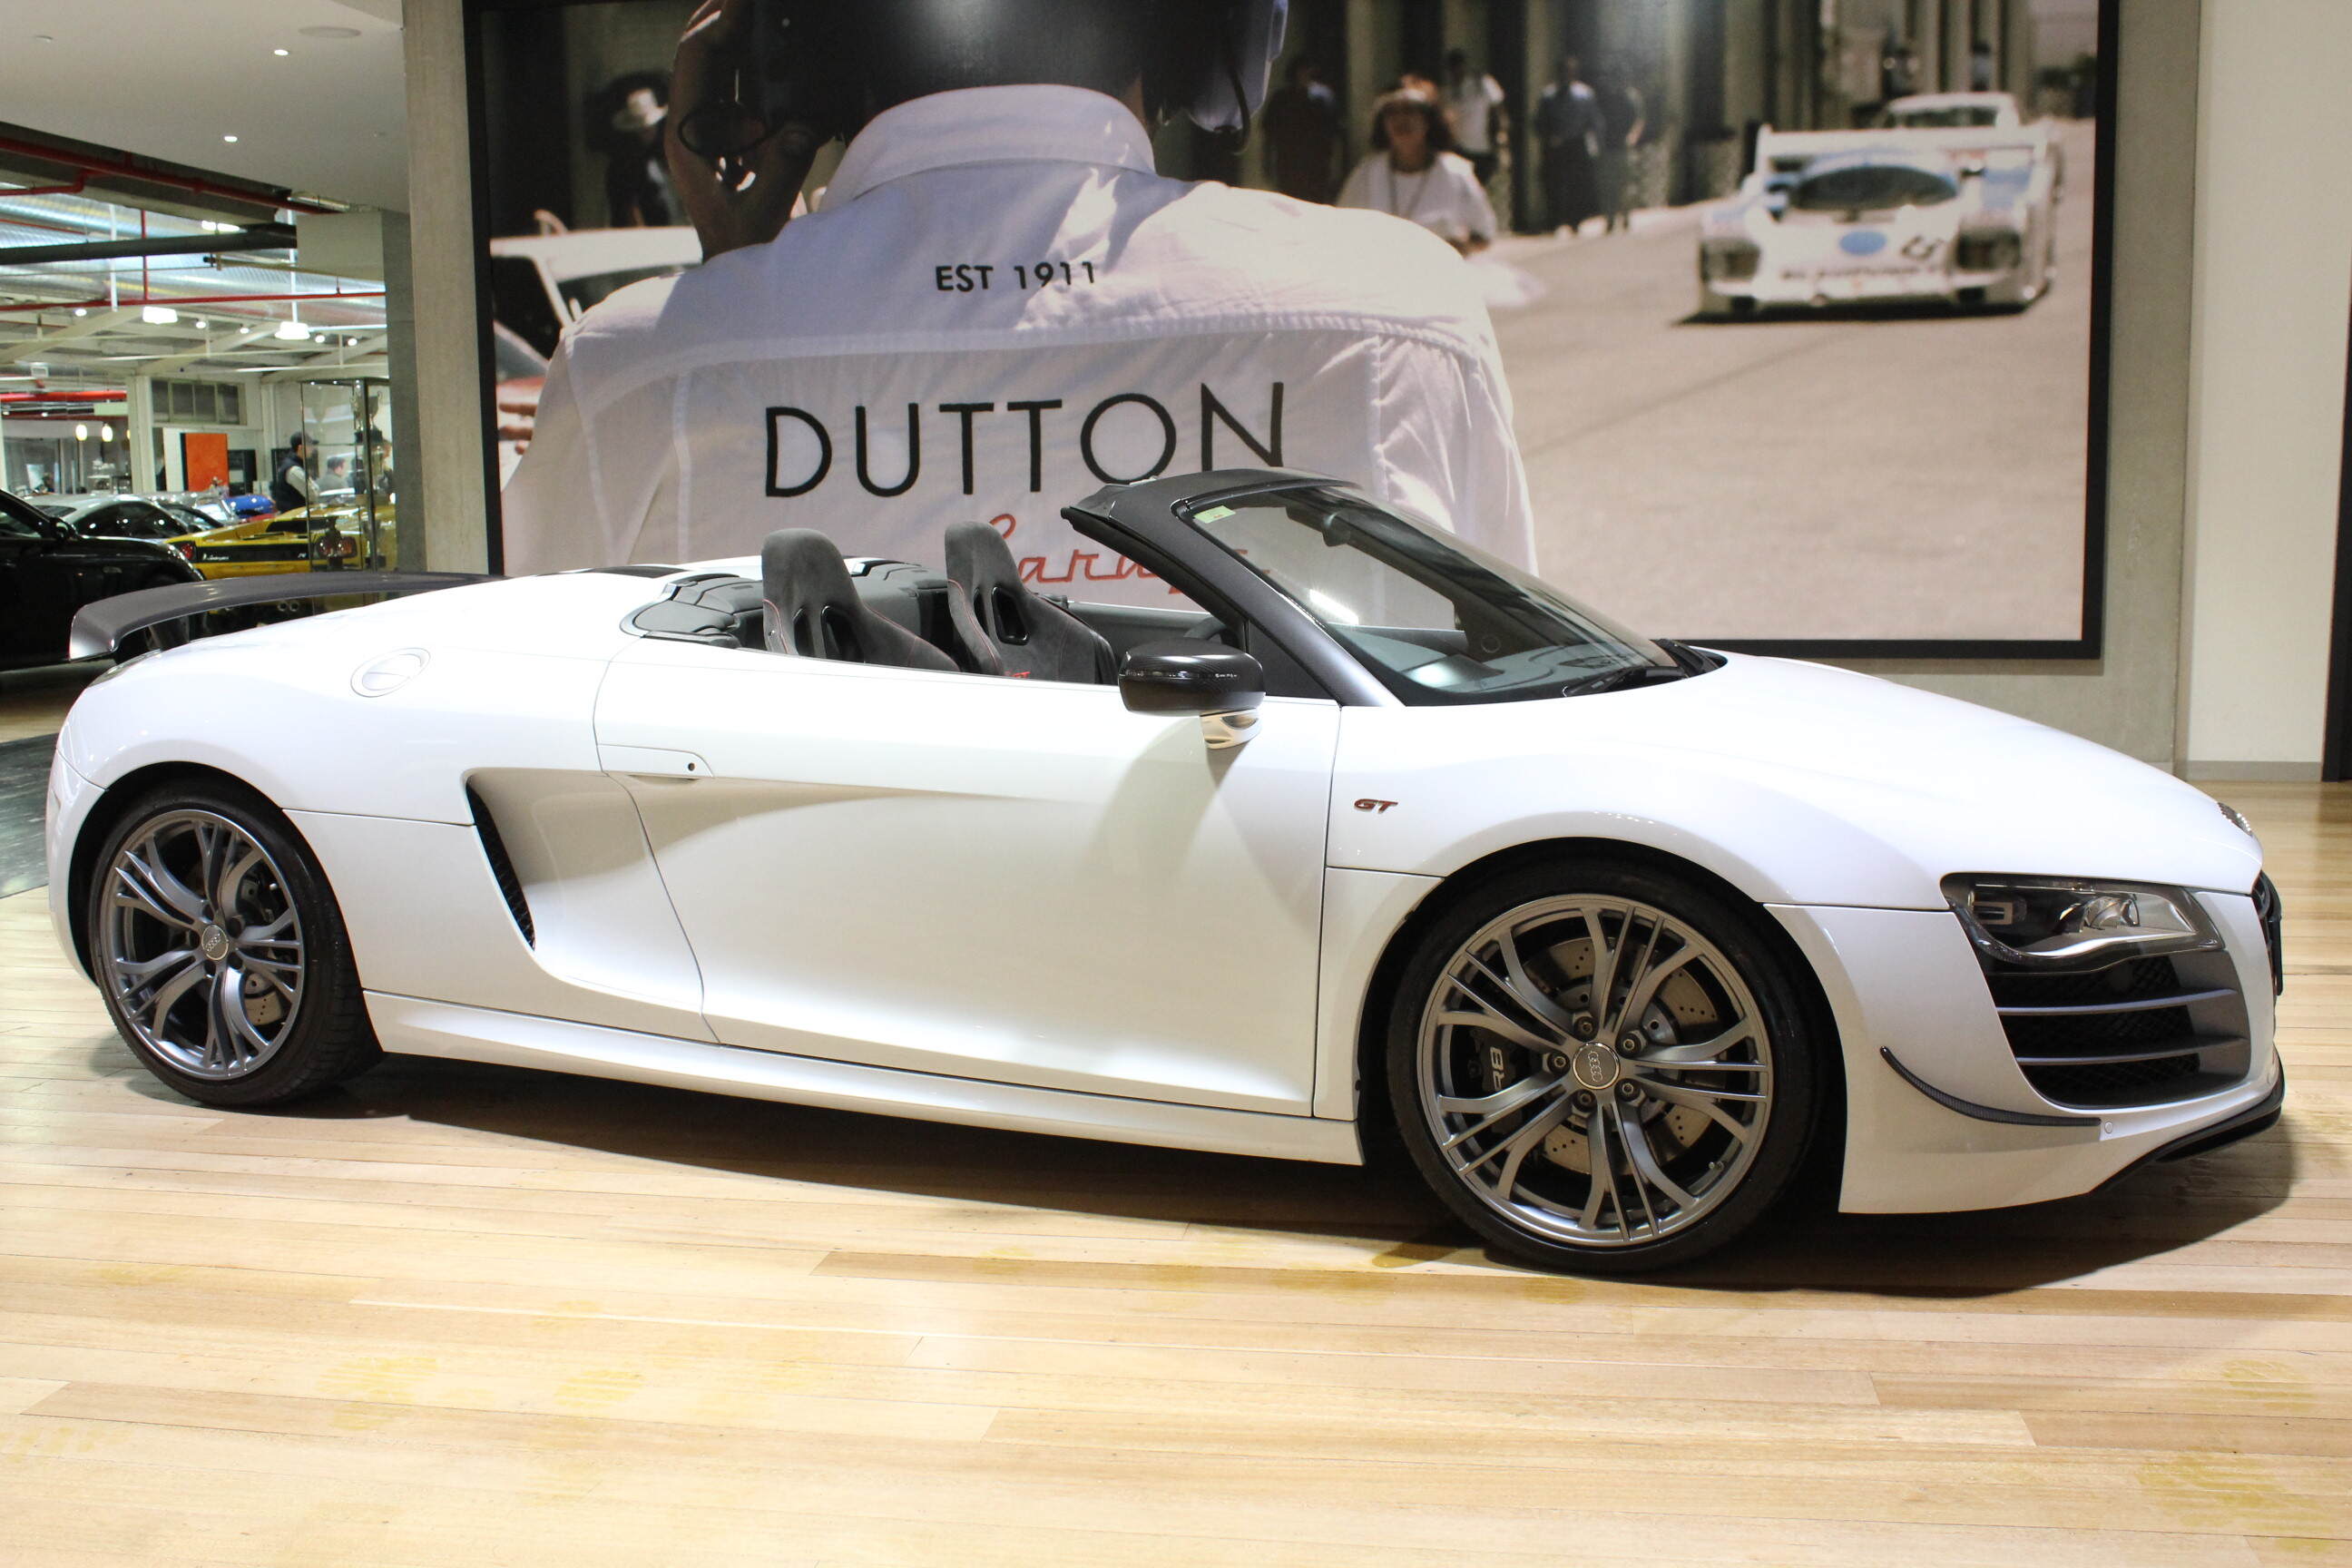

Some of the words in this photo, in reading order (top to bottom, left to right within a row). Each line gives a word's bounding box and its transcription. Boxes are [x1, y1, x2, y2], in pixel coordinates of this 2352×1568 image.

[935, 263, 994, 292] EST
[1013, 261, 1094, 289] 1911
[765, 381, 1284, 498] DUTTON
[1354, 798, 1398, 814] GT
